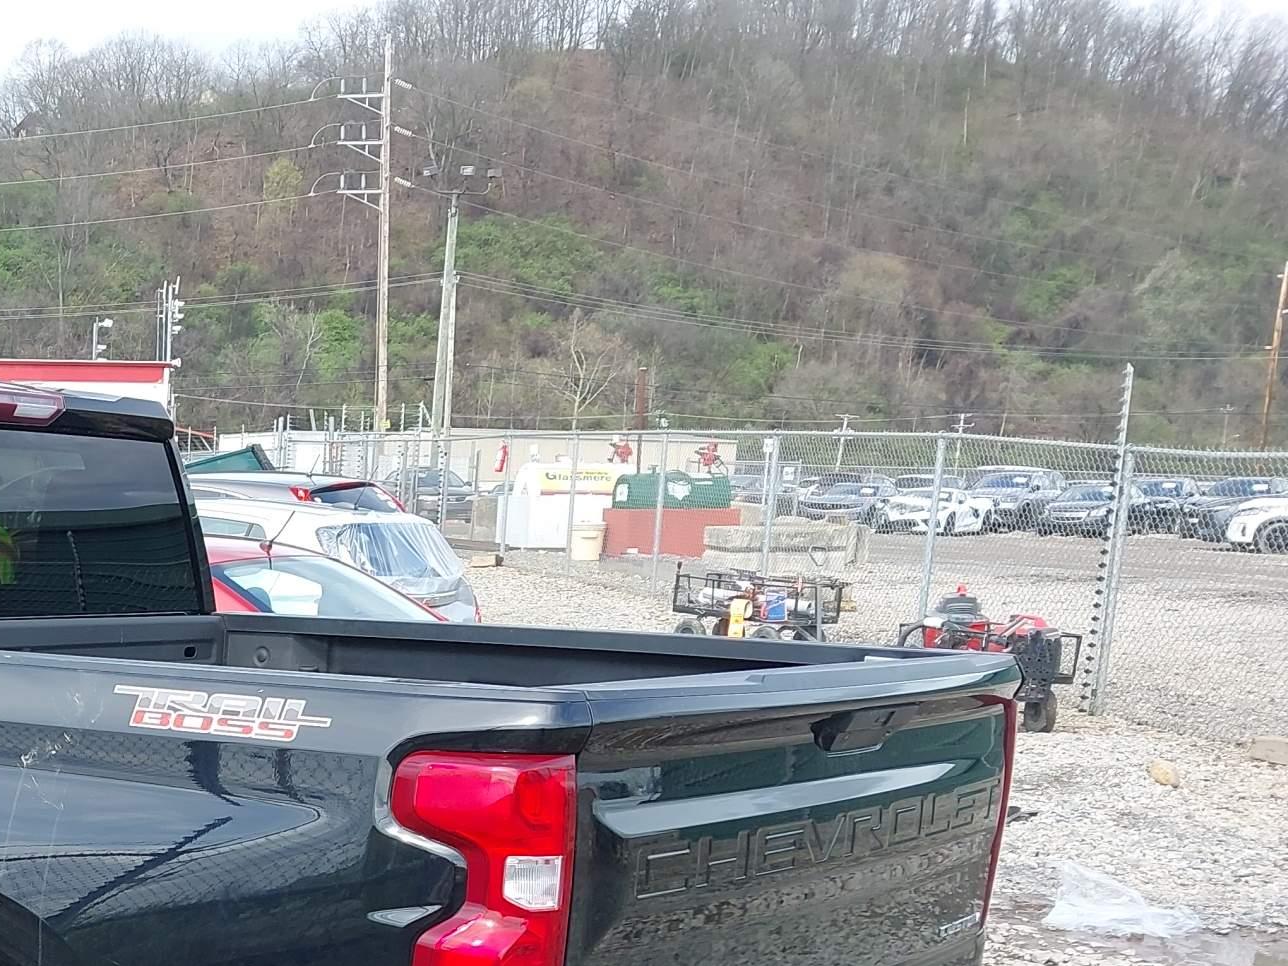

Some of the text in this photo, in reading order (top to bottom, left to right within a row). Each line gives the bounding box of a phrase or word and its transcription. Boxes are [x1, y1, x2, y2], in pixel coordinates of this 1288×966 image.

[114, 684, 332, 727] TRAIL
[129, 709, 300, 742] BOSS
[636, 779, 999, 900] CHEVROLET
